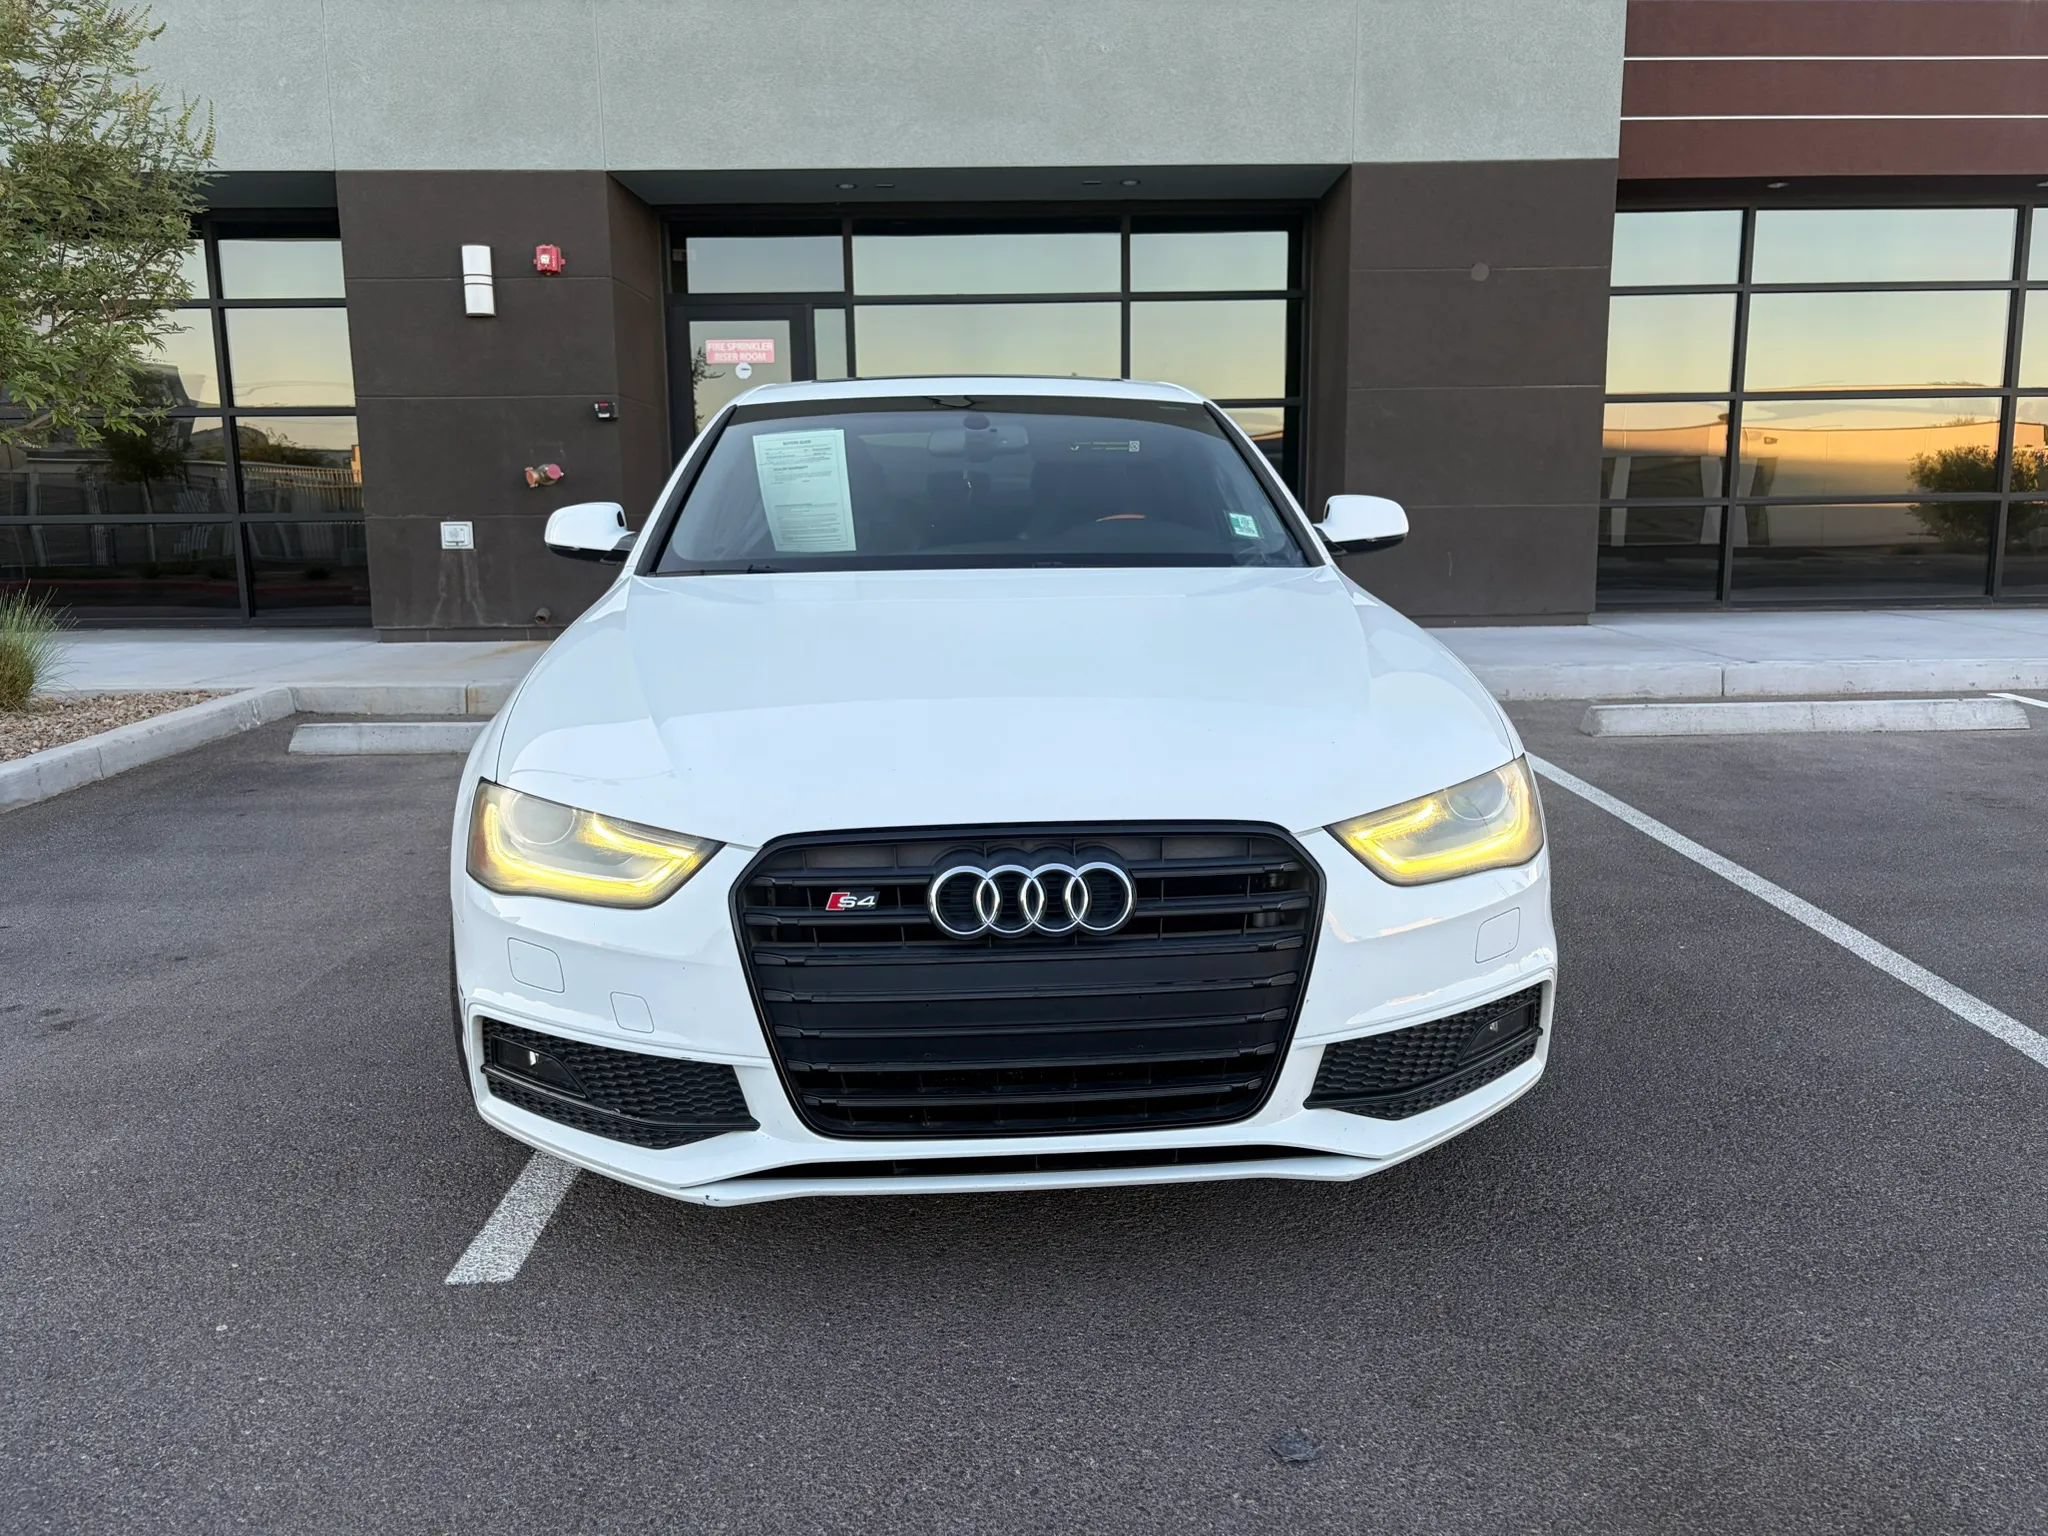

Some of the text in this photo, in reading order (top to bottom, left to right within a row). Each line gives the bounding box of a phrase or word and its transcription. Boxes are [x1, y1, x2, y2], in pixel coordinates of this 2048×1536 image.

[707, 342, 773, 352] FIRE SPRINKLER
[739, 352, 767, 361] ROOM
[837, 896, 876, 908] S4
